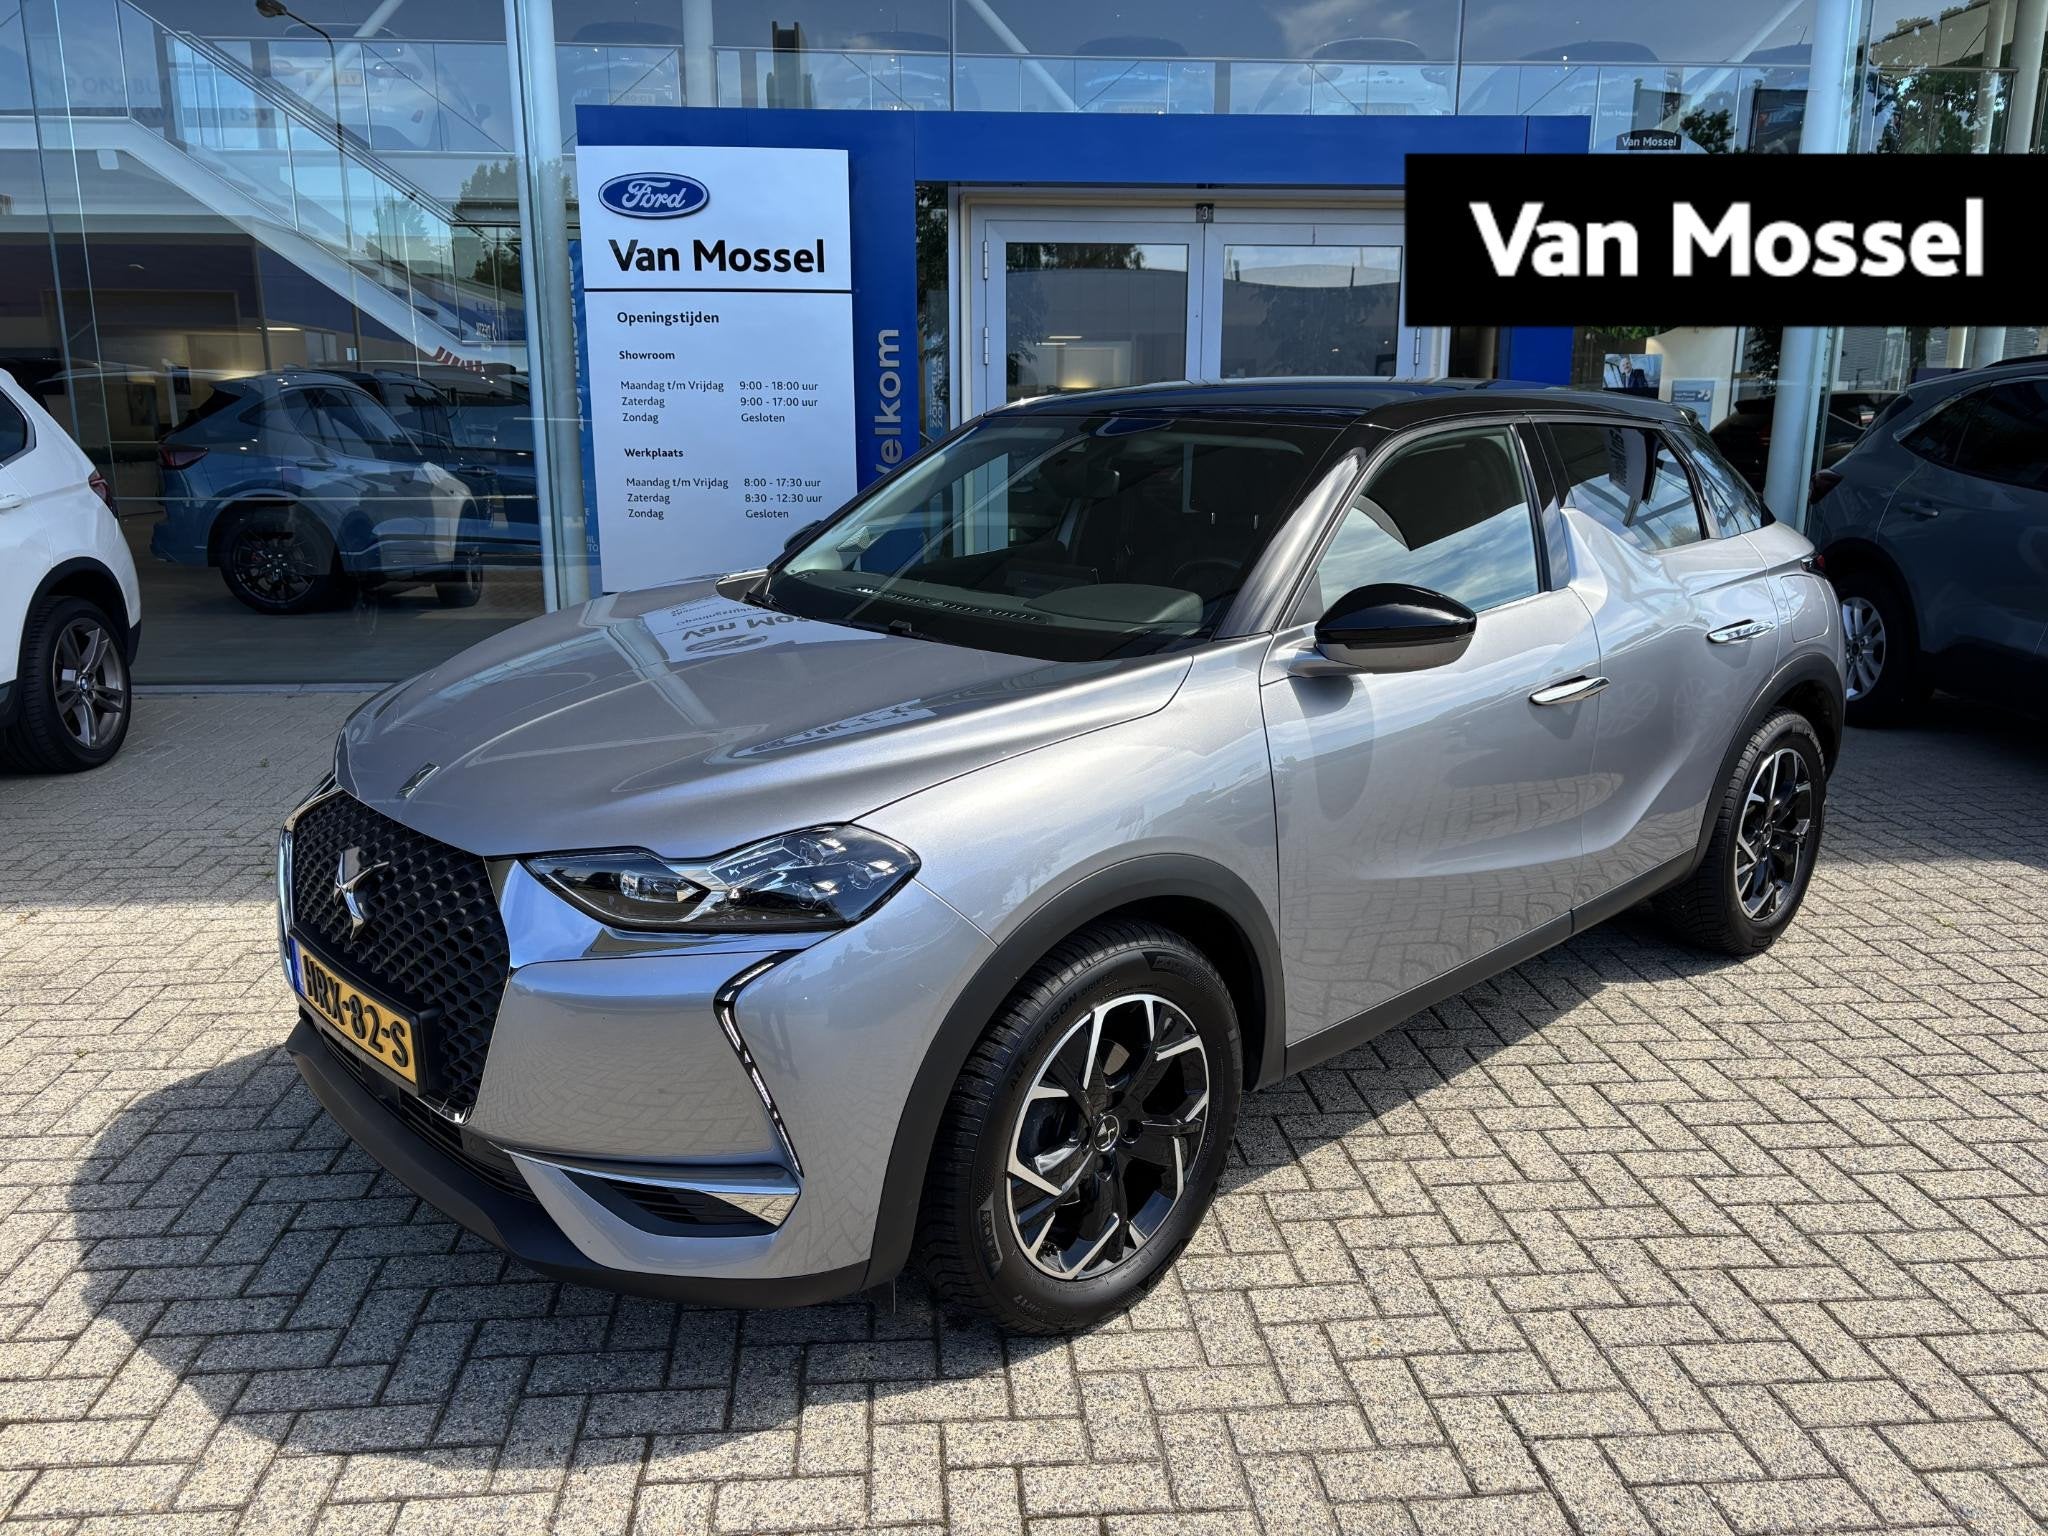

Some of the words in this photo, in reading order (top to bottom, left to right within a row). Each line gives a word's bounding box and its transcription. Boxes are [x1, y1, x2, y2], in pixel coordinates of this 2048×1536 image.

[1621, 136, 1641, 147] Van
[1642, 136, 1677, 147] Mossel
[620, 178, 688, 210] Ford
[608, 239, 680, 272] Van
[692, 238, 825, 273] Mossel
[616, 310, 720, 327] Openingstijden
[618, 349, 676, 360] Showroom
[620, 379, 666, 393] Maandag
[666, 380, 686, 391] t/m
[687, 380, 725, 393] Vrijdag
[739, 380, 763, 391] 9:00
[771, 381, 800, 391] 18:00
[801, 383, 819, 391] uur
[621, 395, 666, 409] Zaterdag
[740, 396, 763, 407] 9:00
[772, 397, 800, 407] 17:00
[801, 399, 819, 407] uur
[622, 412, 659, 425] Zondag
[740, 412, 786, 423] Gesloten
[623, 447, 684, 461] Werkplaats
[626, 477, 671, 490] Maandag
[672, 477, 691, 487] t/m
[692, 477, 729, 490] Vrijdag
[743, 477, 767, 487] 8:00
[775, 478, 803, 488] 17:30
[626, 492, 671, 505] Zaterdag
[744, 493, 767, 503] 8:30
[776, 493, 804, 503] 12:30
[806, 495, 823, 503] uur
[627, 508, 665, 521] Zondag
[745, 508, 789, 519] Gesloten
[303, 955, 409, 1068] HRX-82-S
